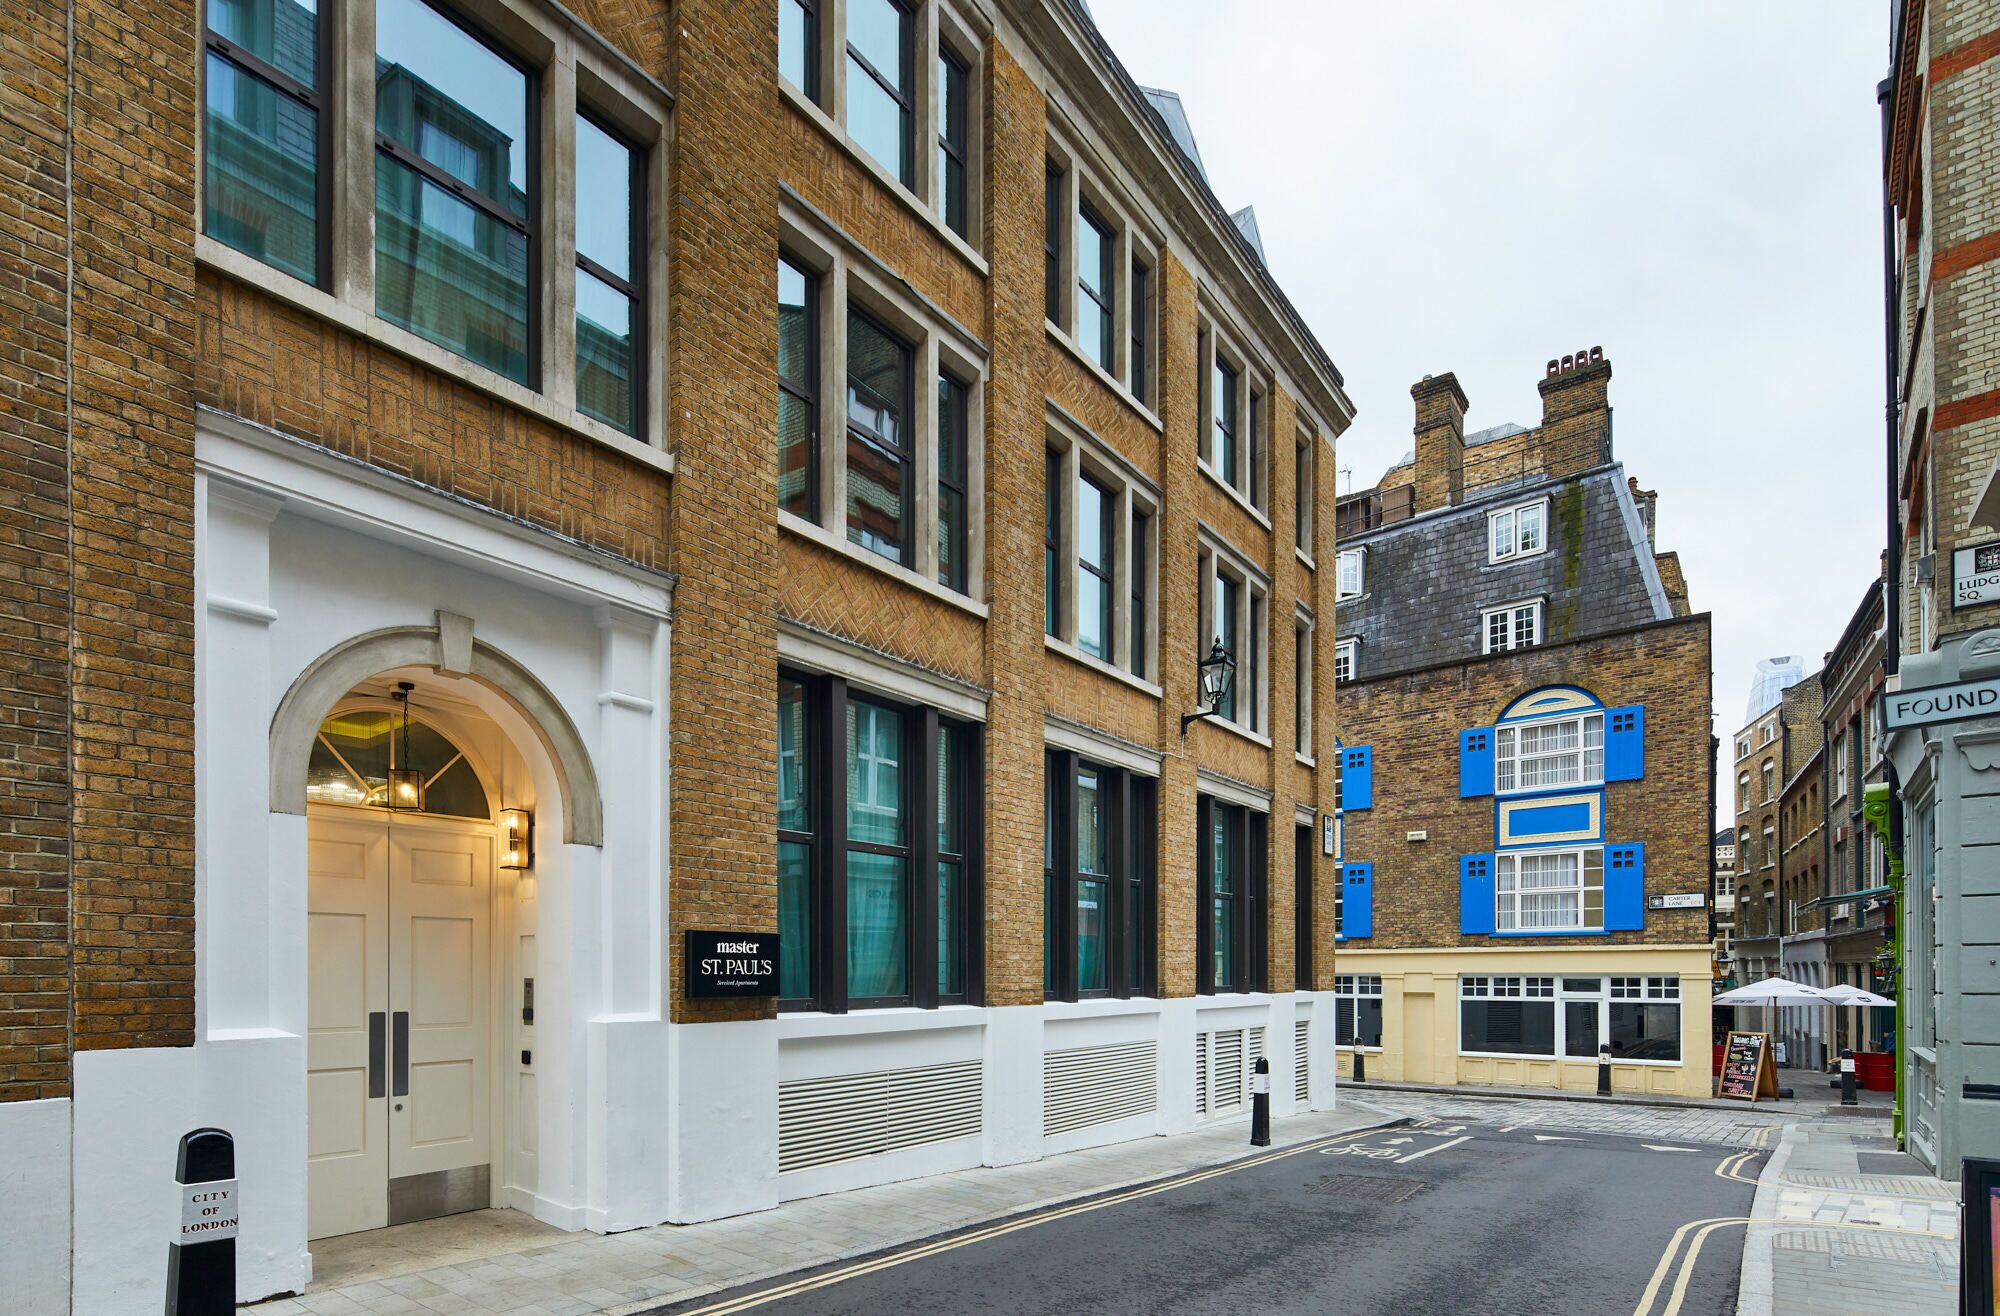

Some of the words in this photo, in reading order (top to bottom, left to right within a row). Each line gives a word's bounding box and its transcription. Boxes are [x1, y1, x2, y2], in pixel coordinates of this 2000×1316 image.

[1959, 575, 1999, 590] LUDG
[1959, 590, 1982, 601] SQ.
[1897, 688, 1998, 718] FOUND
[717, 940, 759, 954] master
[701, 959, 723, 975] ST.
[726, 959, 772, 975] PAUL'S
[192, 1190, 230, 1203] CITY
[202, 1206, 220, 1216] OF
[182, 1218, 238, 1234] LONDON
